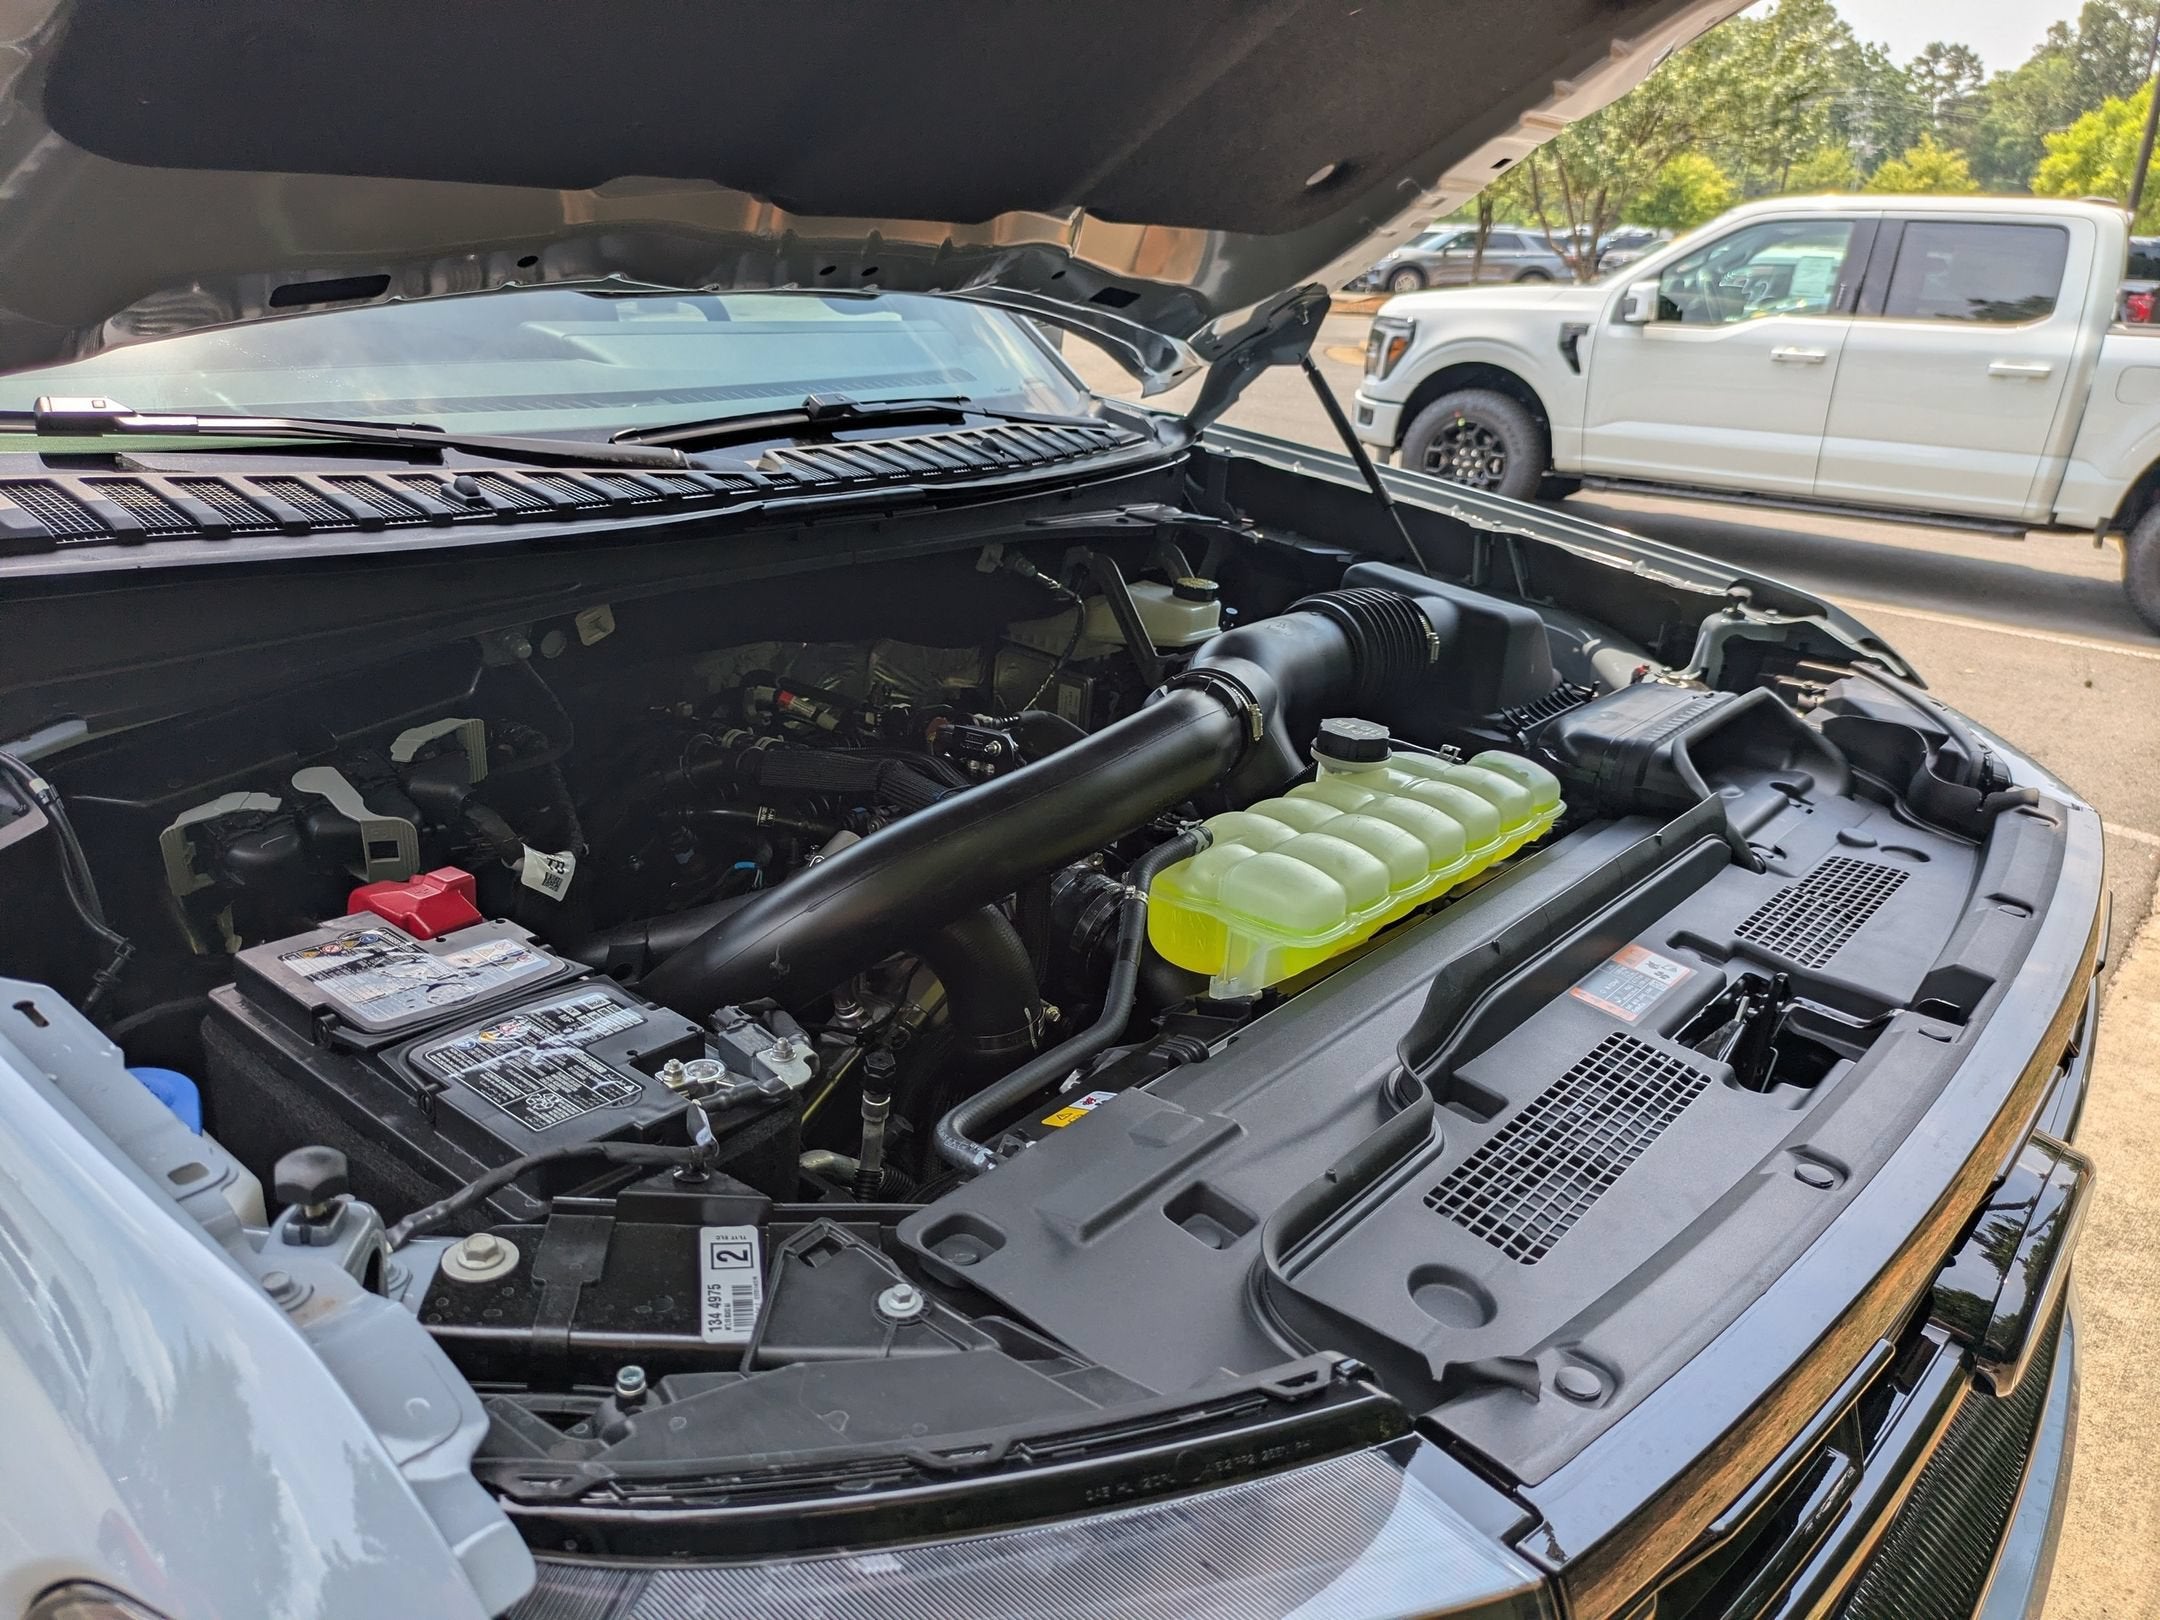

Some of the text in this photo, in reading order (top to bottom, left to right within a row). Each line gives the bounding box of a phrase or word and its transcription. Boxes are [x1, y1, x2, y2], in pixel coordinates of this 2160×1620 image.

[716, 1249, 749, 1263] 2
[707, 1283, 722, 1333] 134 4975
